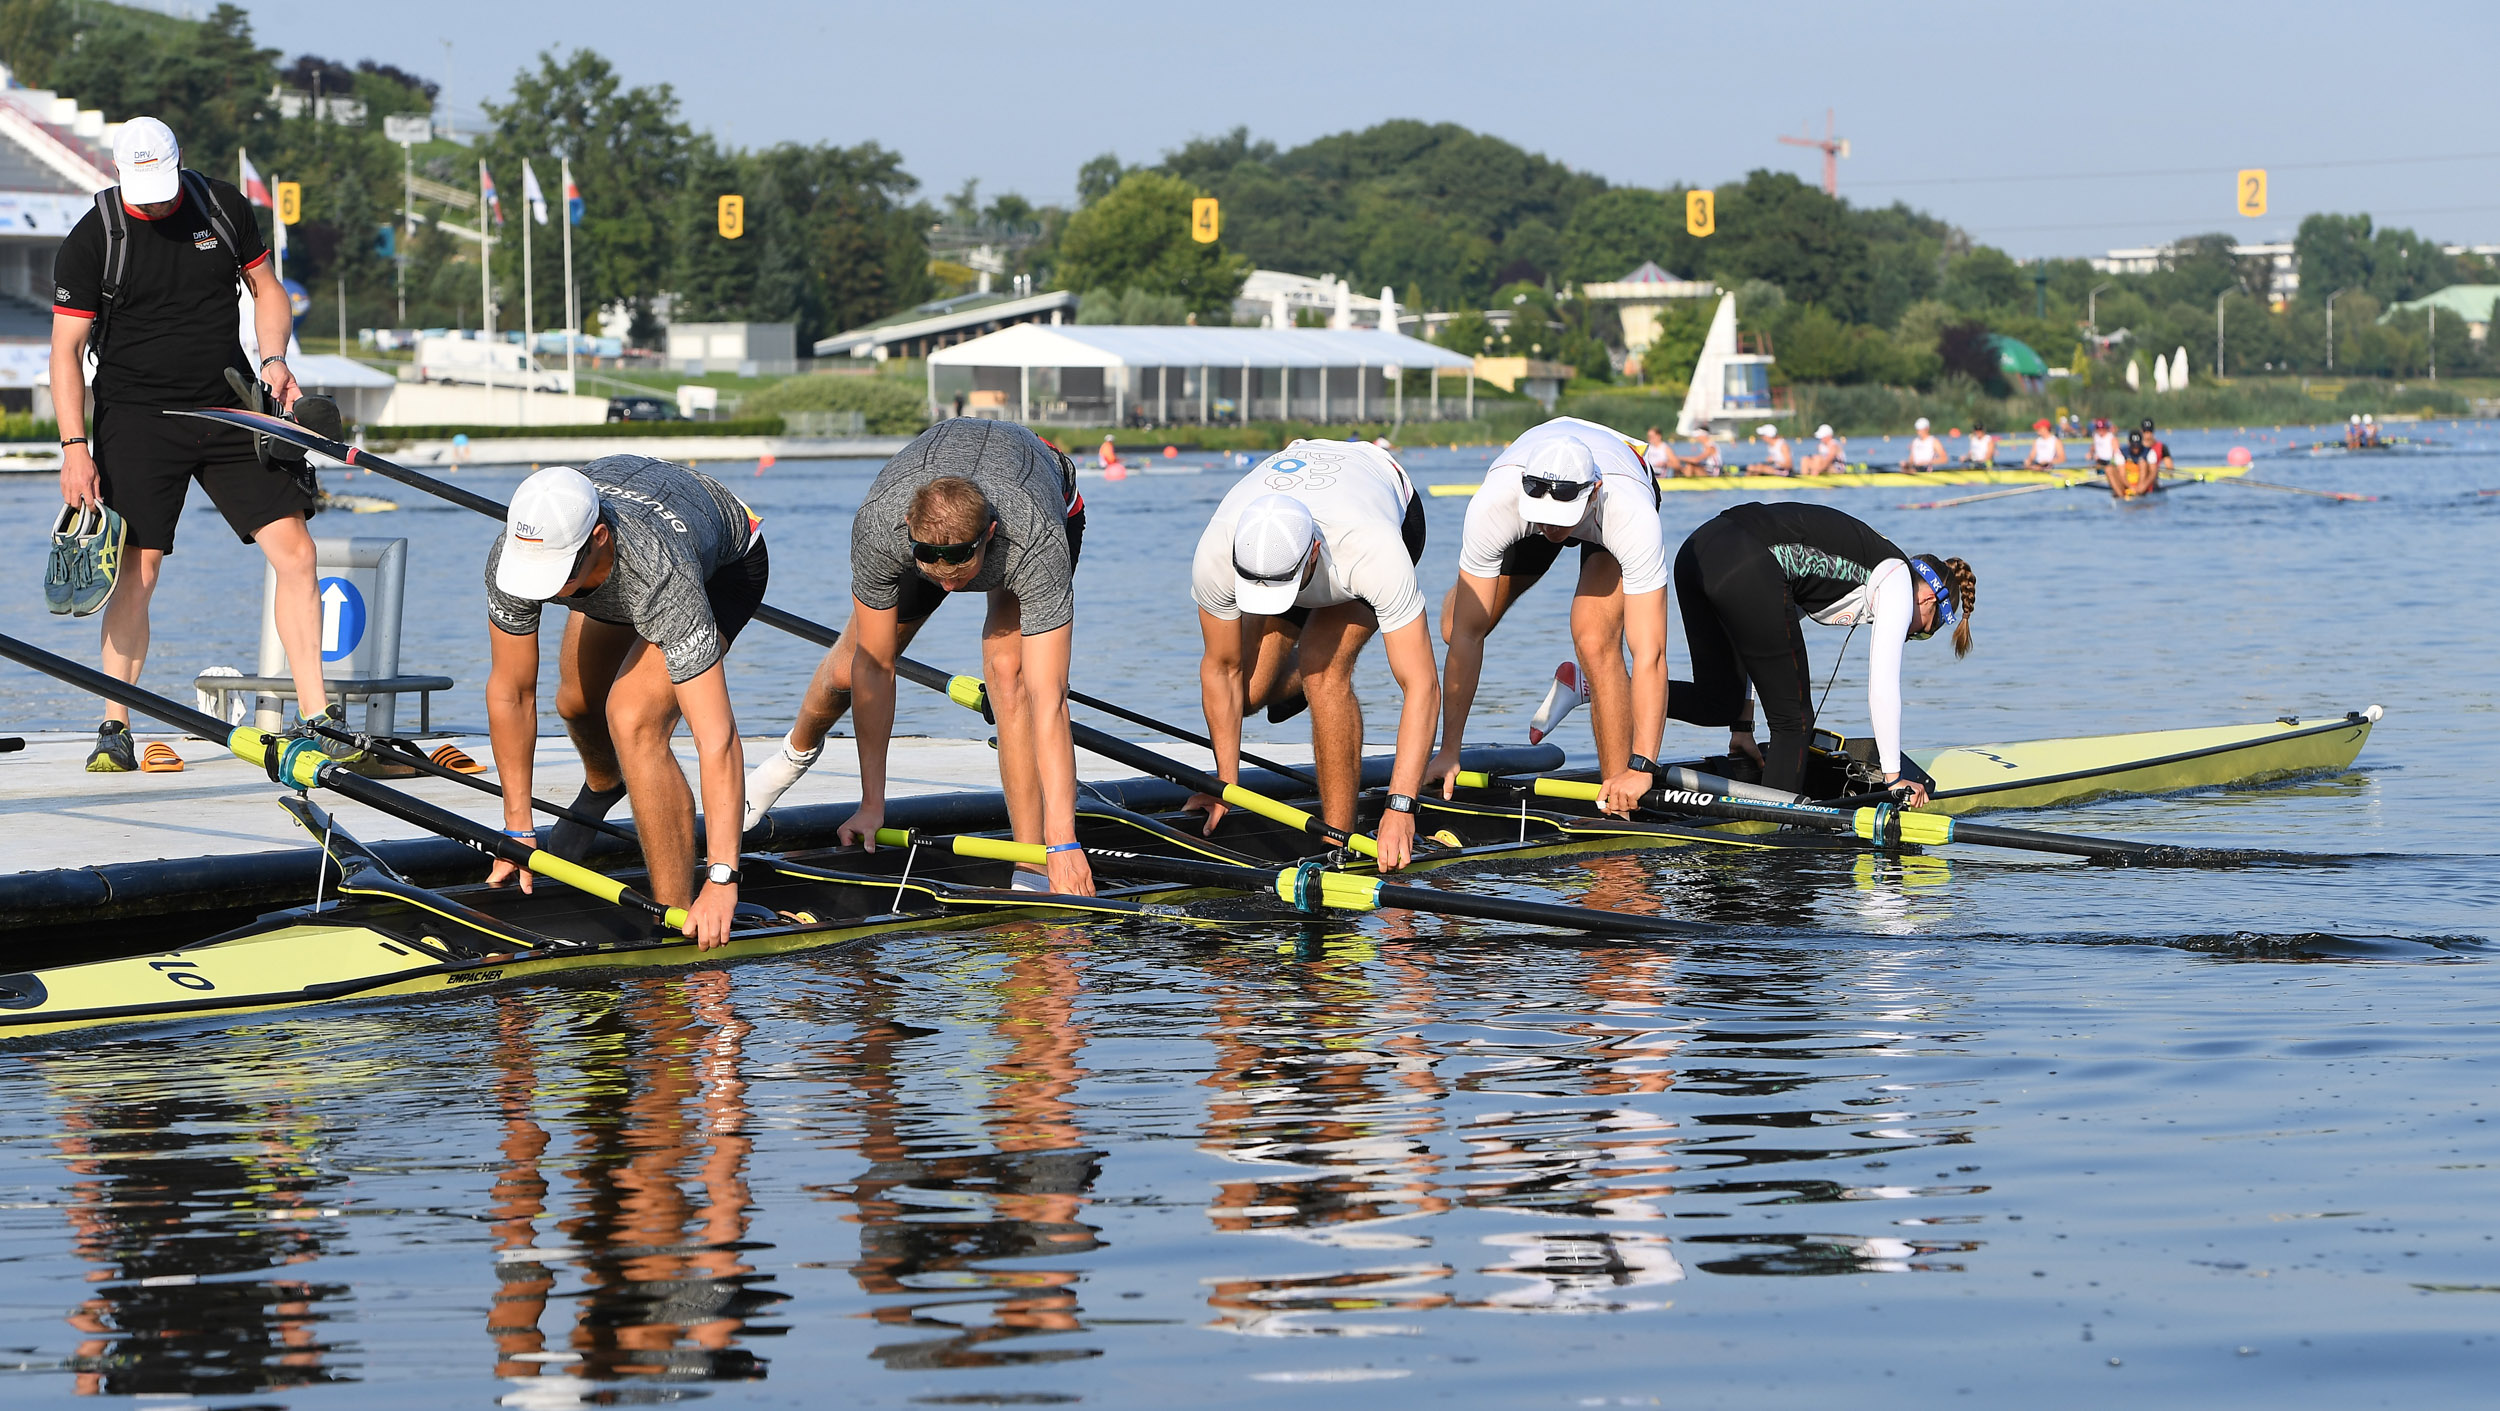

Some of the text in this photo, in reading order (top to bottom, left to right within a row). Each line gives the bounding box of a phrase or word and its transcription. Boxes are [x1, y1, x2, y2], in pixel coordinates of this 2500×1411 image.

[134, 150, 151, 159] DRV
[2246, 177, 2259, 208] 2
[283, 189, 294, 216] 6
[725, 202, 737, 230] 5
[1199, 206, 1212, 233] 4
[1694, 198, 1707, 228] 3
[193, 230, 209, 240] DRV
[516, 521, 536, 535] DRV
[1916, 563, 1931, 576] NK
[1792, 803, 1840, 815] SKINNY
[446, 969, 504, 985] EMPACHER
